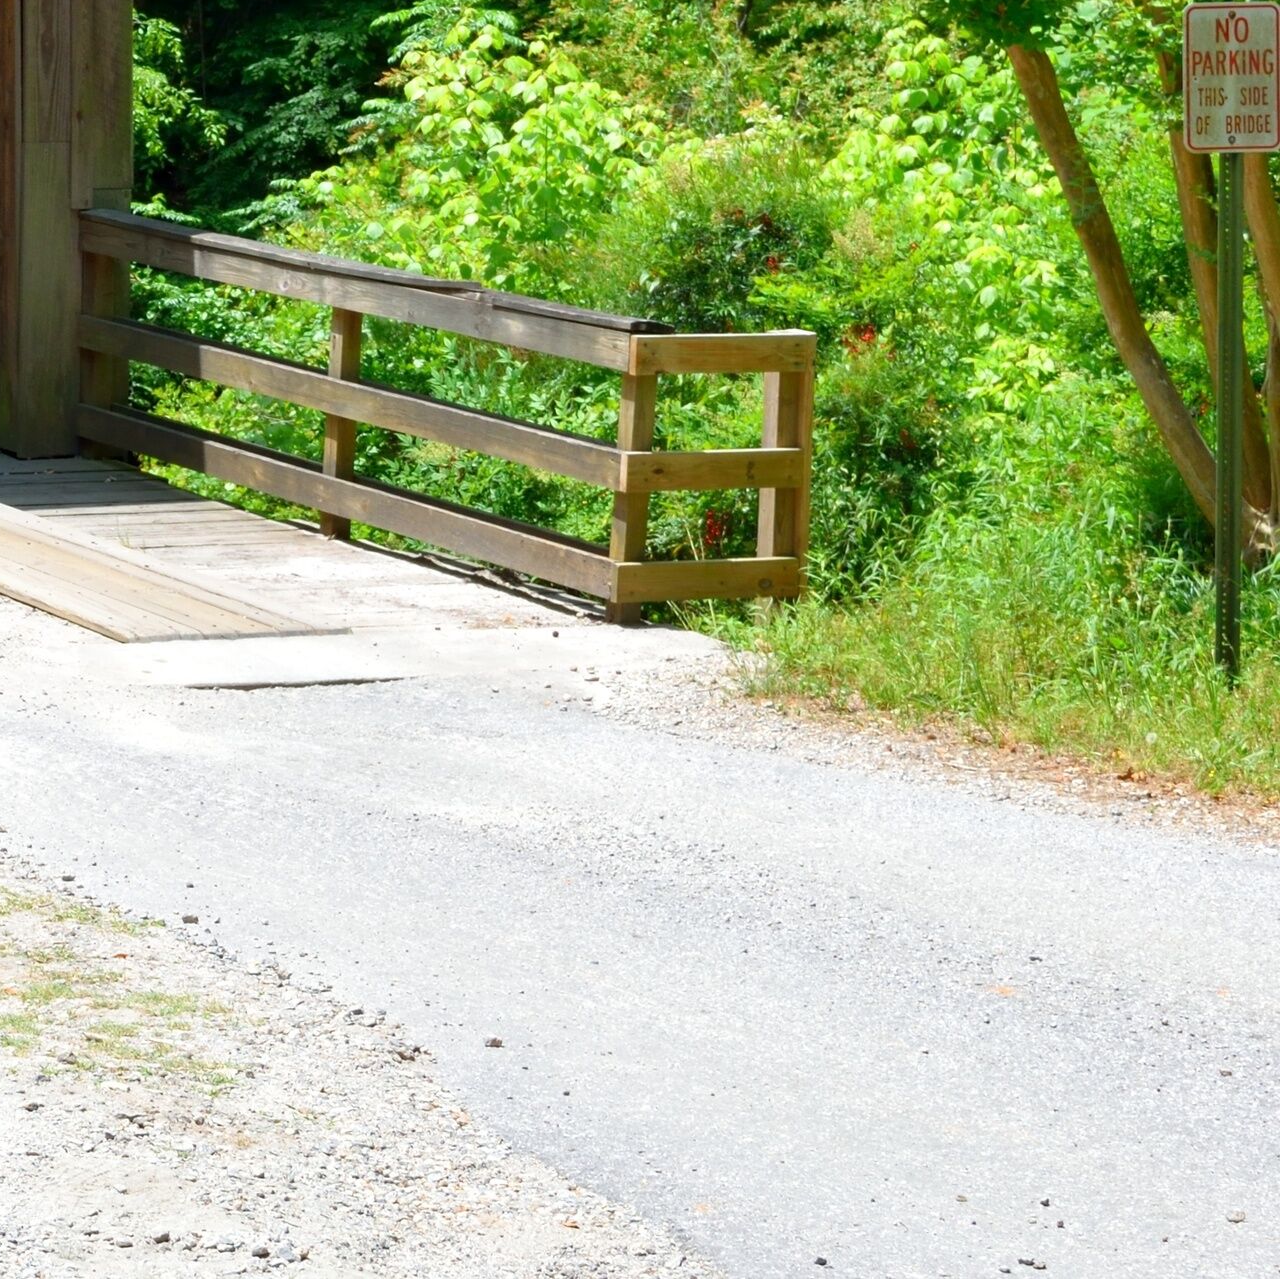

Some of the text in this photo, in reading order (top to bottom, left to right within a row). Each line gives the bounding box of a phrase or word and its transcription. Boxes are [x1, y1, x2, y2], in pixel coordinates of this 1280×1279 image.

[1215, 17, 1249, 43] NO
[1192, 49, 1274, 76] PARKING
[1198, 86, 1268, 106] THIS SIDE
[1196, 114, 1271, 135] OF BRIDGE
